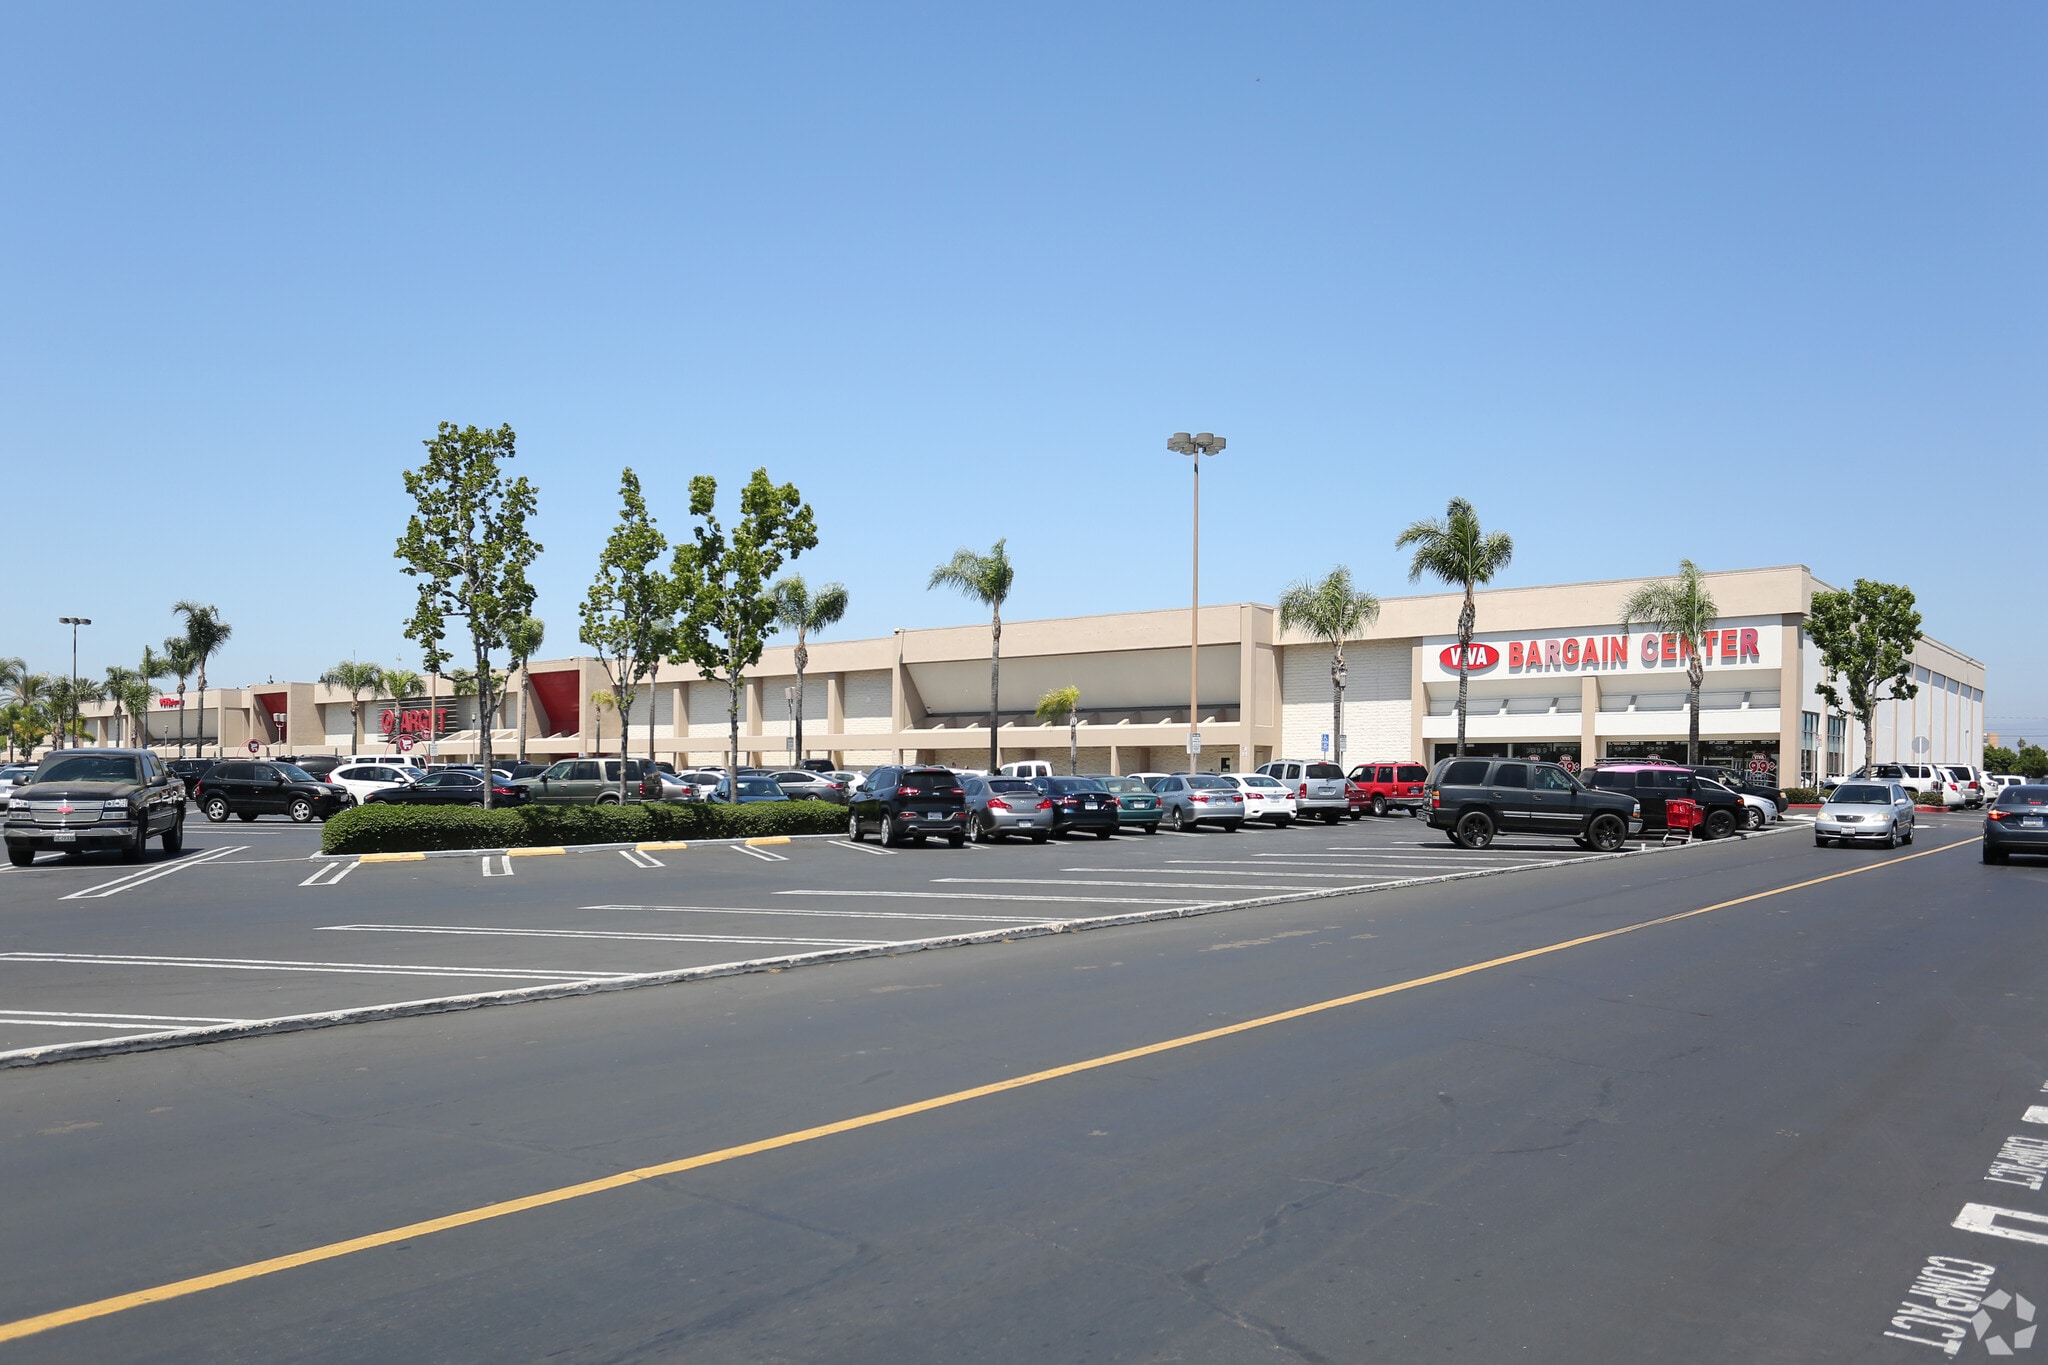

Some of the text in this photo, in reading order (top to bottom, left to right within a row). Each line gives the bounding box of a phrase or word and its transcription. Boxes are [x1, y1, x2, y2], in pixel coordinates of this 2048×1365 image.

[1450, 628, 1760, 668] VVA BARGAIN CENTER
[1883, 1255, 1996, 1355] COMPACT
